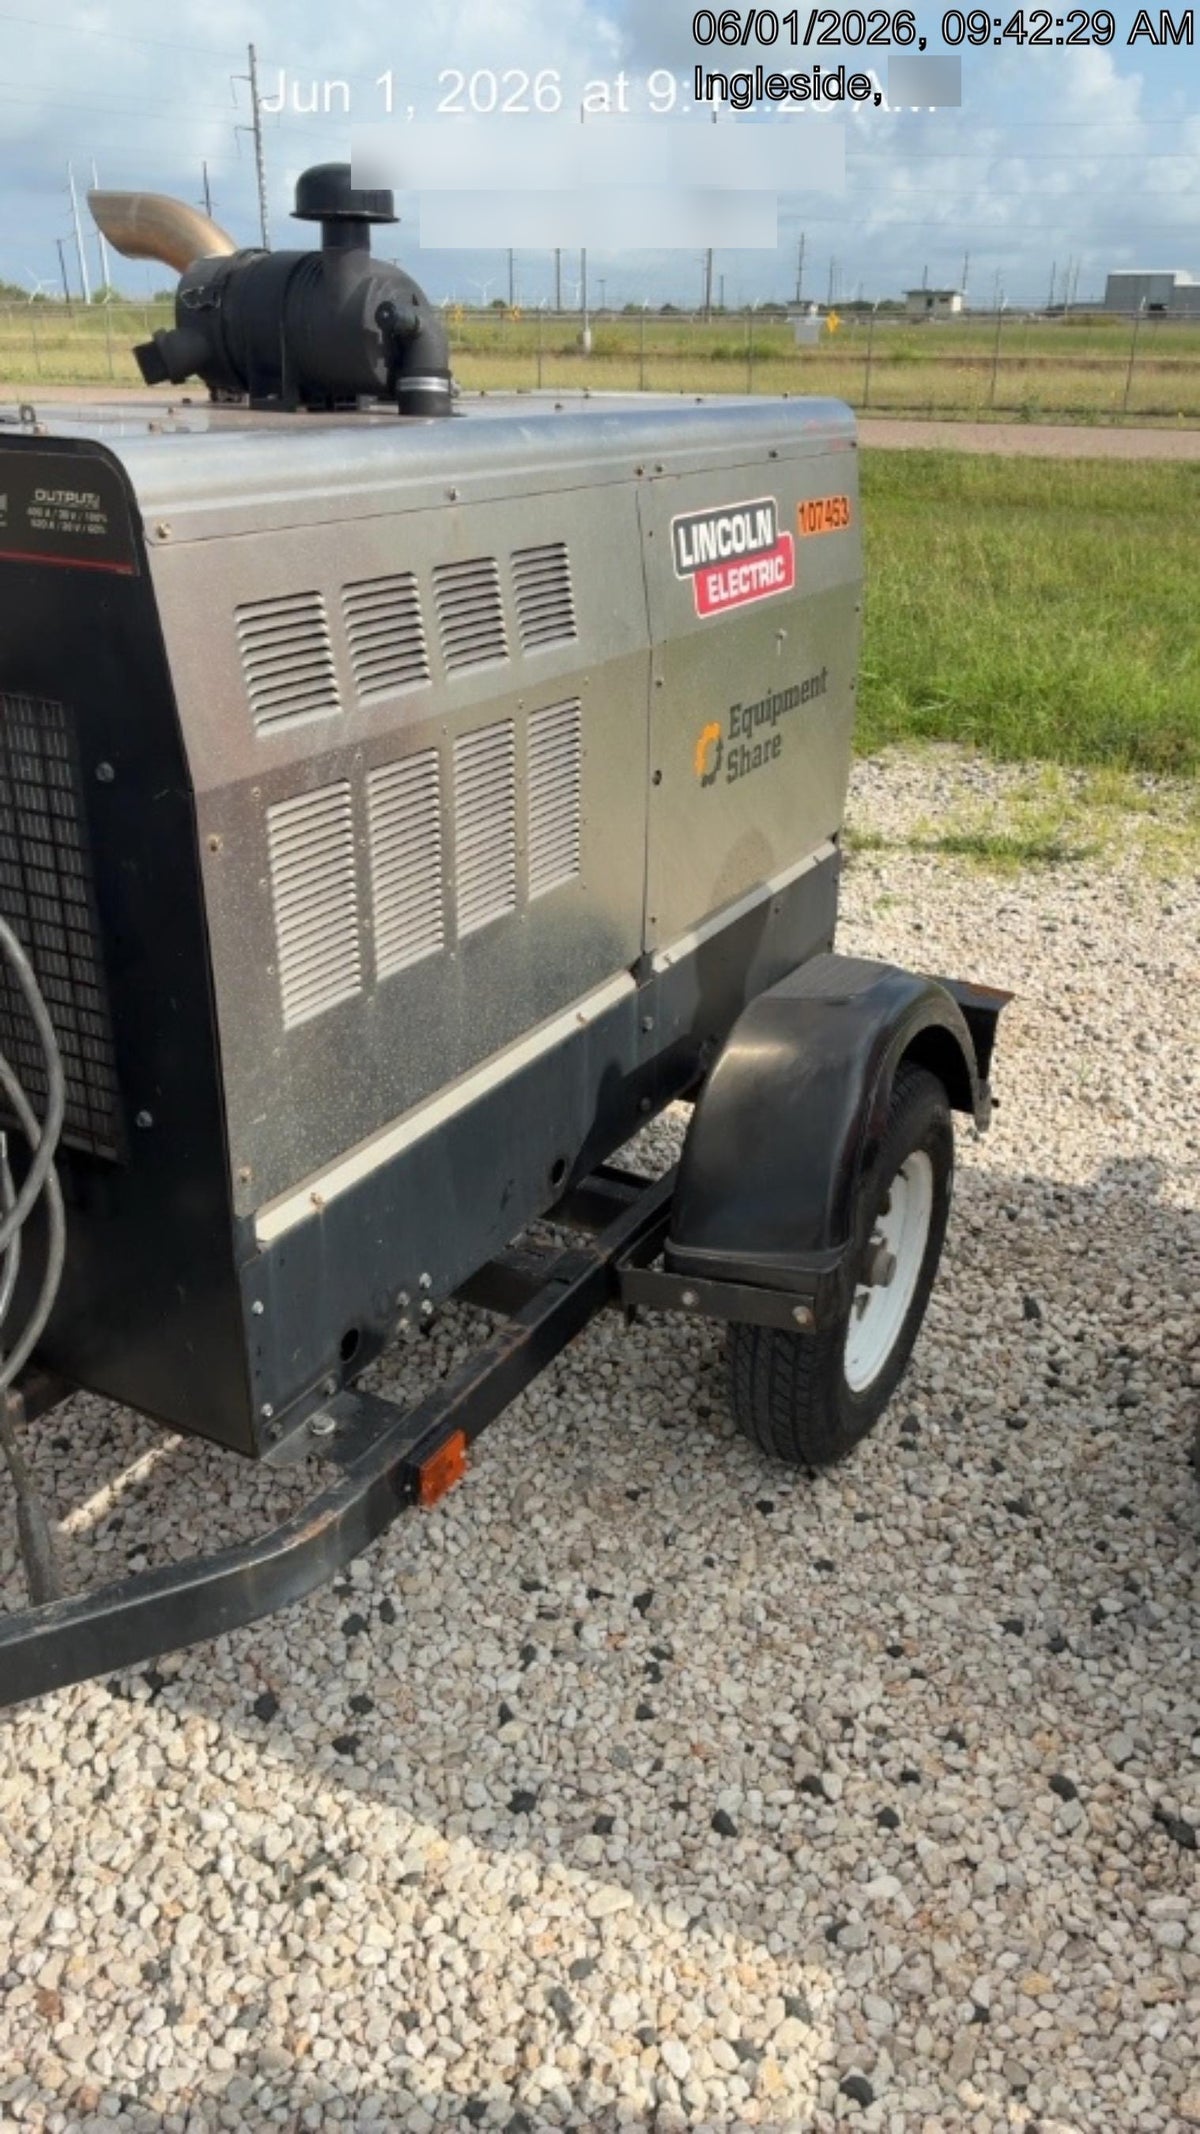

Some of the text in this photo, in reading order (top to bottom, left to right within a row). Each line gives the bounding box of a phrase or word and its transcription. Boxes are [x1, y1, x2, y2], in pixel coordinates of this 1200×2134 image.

[678, 508, 773, 567] LINCOLN
[798, 496, 848, 532] 107453
[707, 555, 785, 603] ELECTRIC
[727, 666, 828, 740] Equipment
[726, 733, 782, 784] Share
